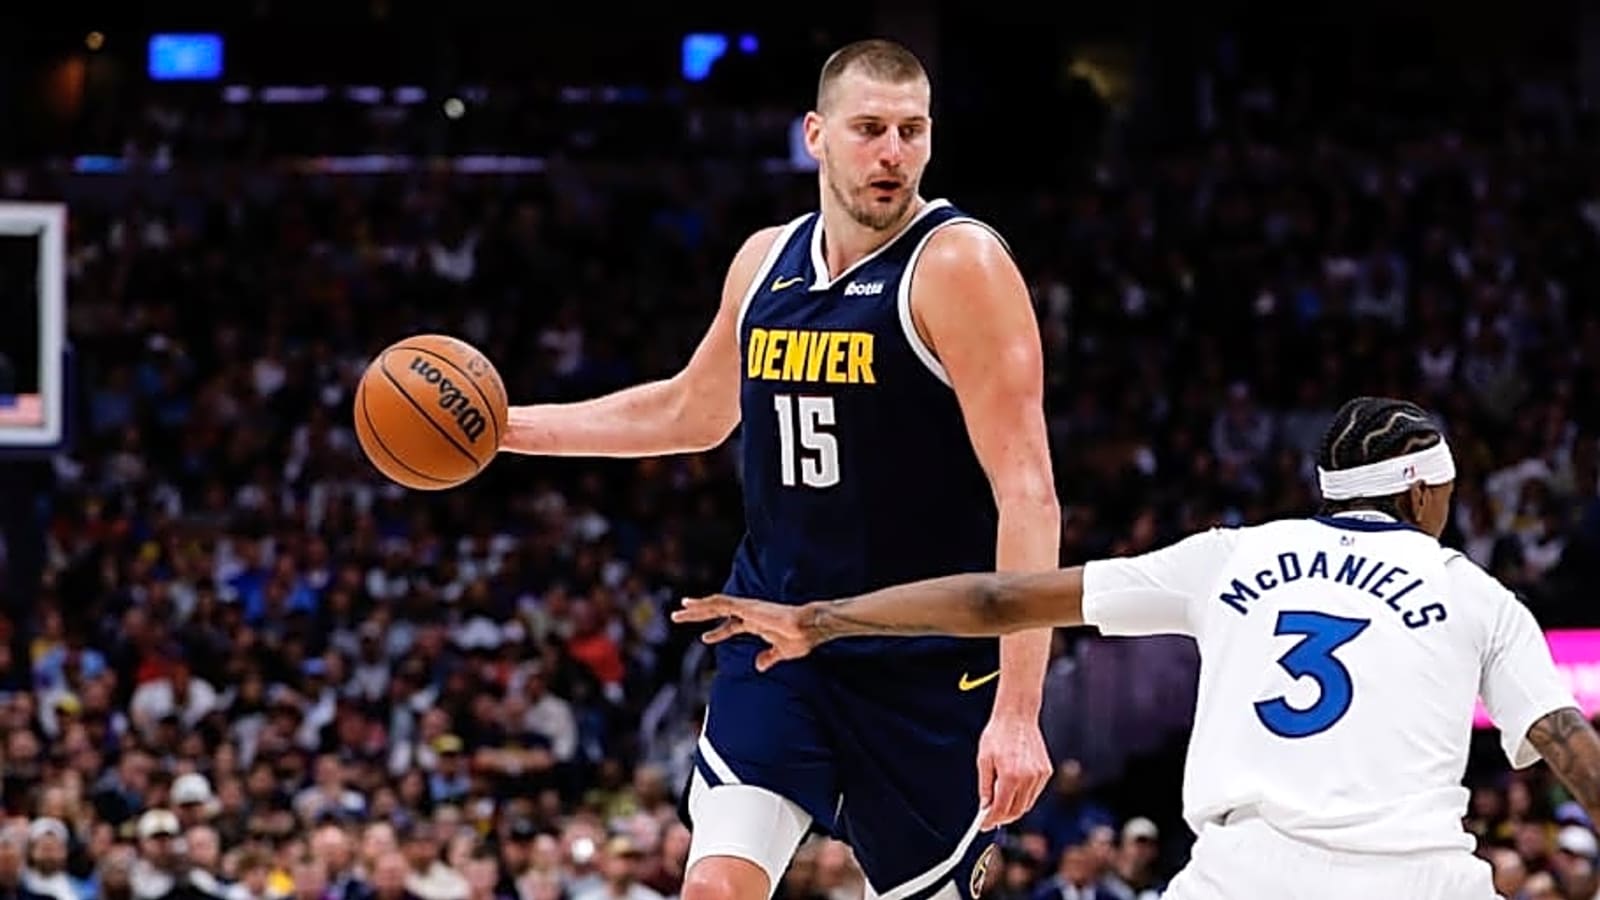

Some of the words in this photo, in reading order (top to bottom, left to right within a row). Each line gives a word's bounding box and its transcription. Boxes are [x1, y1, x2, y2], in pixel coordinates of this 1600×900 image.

[748, 328, 876, 384] DENVER
[410, 357, 486, 443] Wilson
[774, 394, 840, 488] 15
[1219, 551, 1447, 629] McDANIELS
[1253, 610, 1371, 738] 3
